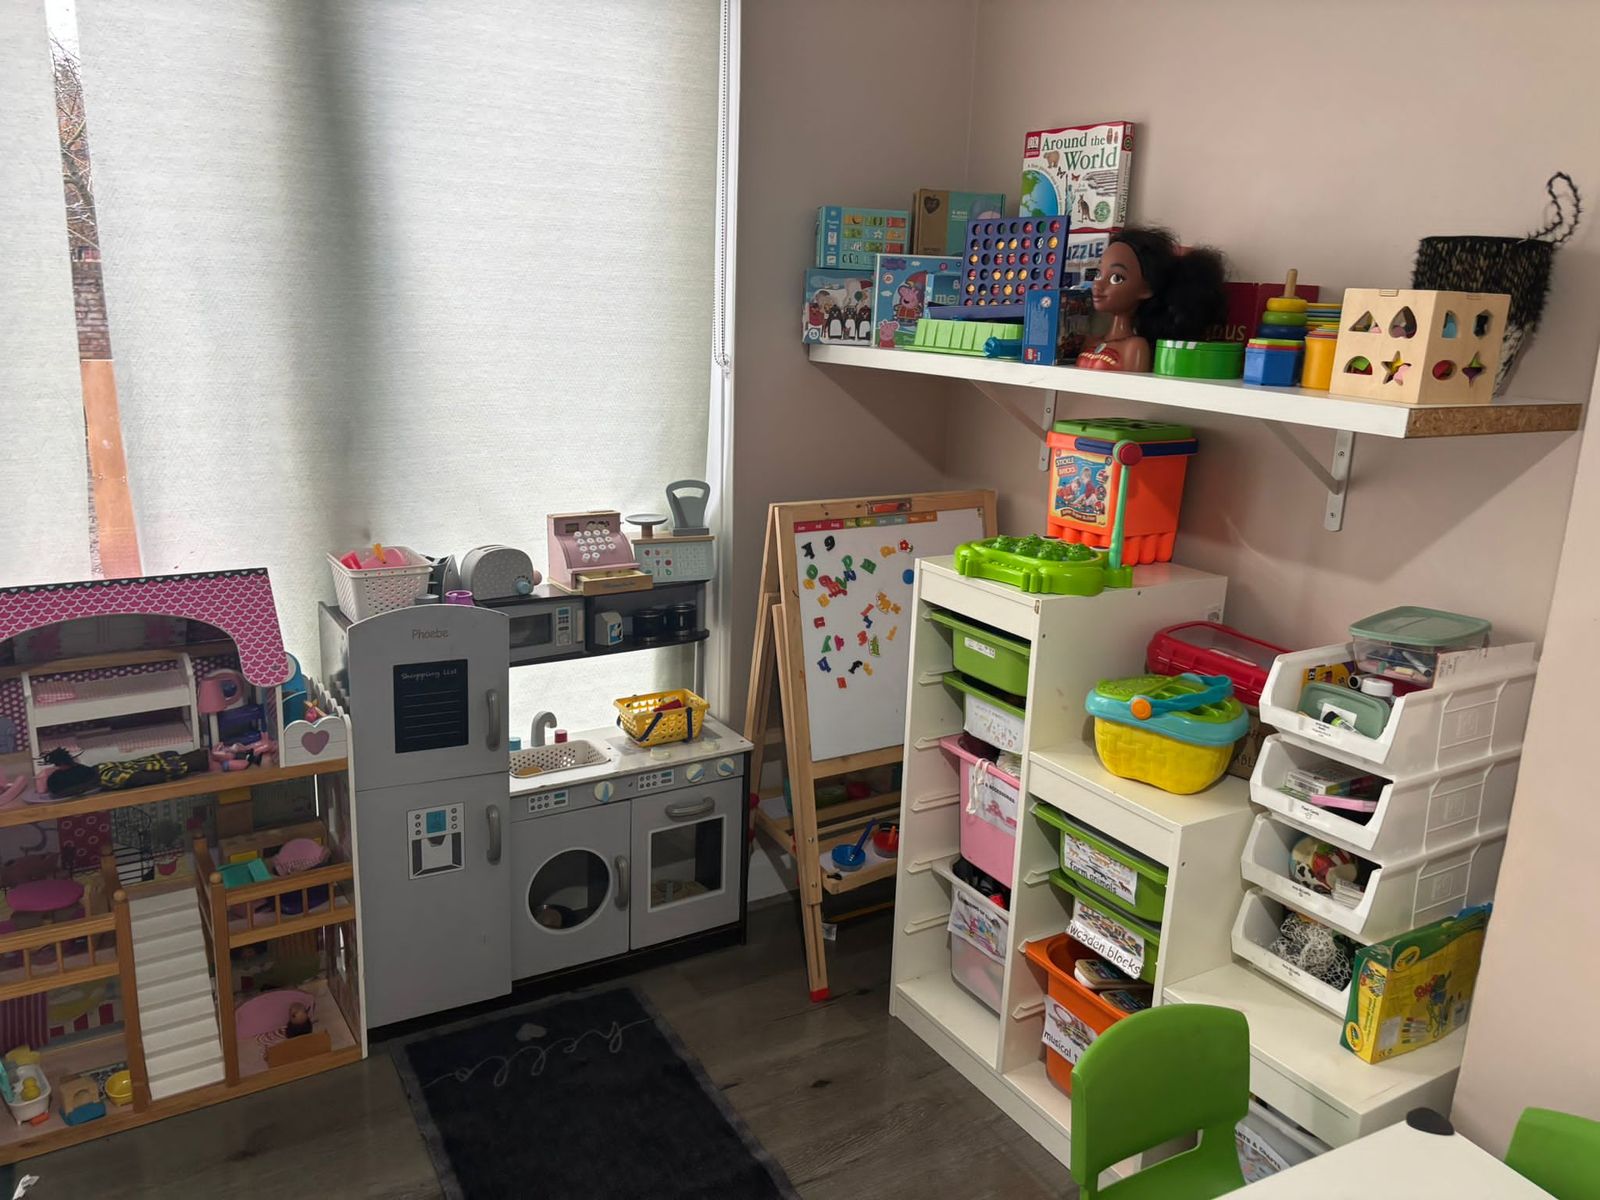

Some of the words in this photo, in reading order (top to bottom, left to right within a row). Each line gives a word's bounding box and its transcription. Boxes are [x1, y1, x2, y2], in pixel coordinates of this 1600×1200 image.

[1042, 133, 1088, 151] Around
[1090, 135, 1105, 146] the
[1064, 147, 1118, 171] World
[1070, 861, 1089, 880] farm
[1090, 874, 1117, 895] animals
[1069, 925, 1106, 954] wooden
[1107, 946, 1140, 975] blocks
[1043, 1031, 1072, 1058] musical
